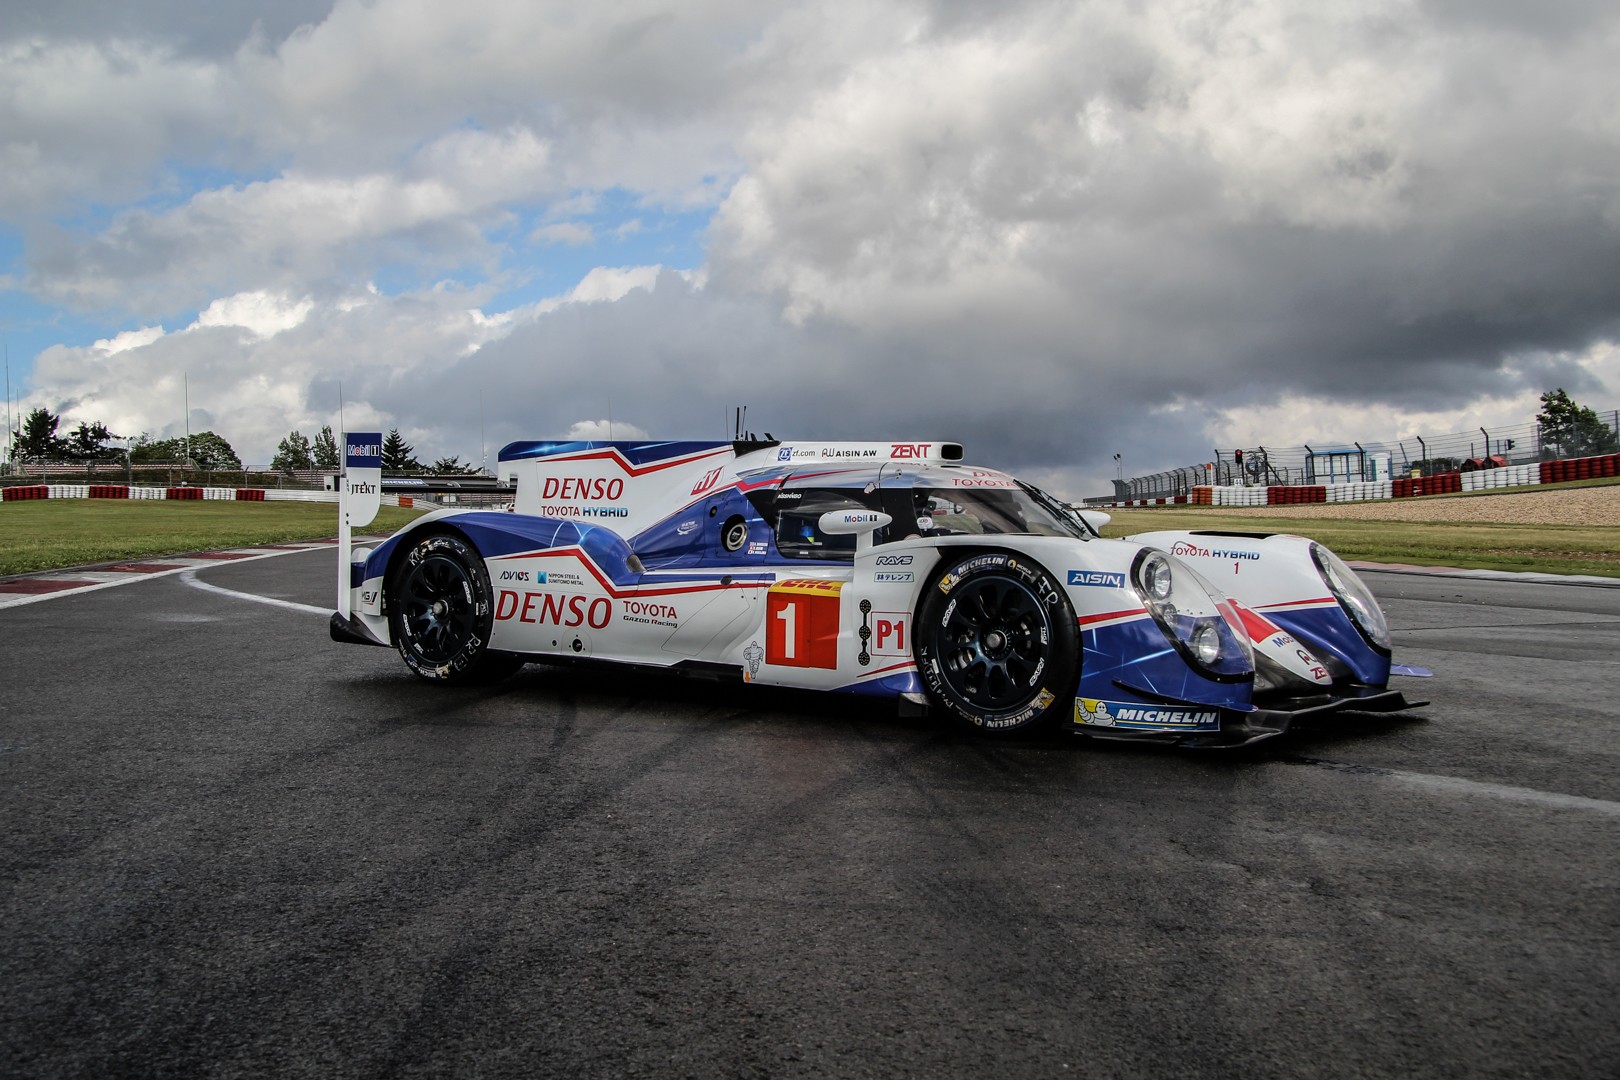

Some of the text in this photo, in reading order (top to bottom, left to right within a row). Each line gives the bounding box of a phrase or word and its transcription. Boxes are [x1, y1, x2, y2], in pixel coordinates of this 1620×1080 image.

[348, 445, 379, 456] Mobil 1
[791, 449, 816, 457] zf.com
[890, 444, 931, 459] ZENT
[351, 482, 376, 495] JTEKT
[542, 477, 624, 500] DENSO
[541, 505, 628, 517] TOYOTA HYBRID
[876, 556, 913, 565] RAYS
[1212, 549, 1260, 560] HYBRID
[957, 557, 1004, 575] MICHELIN
[1233, 562, 1239, 574] 1
[500, 571, 529, 581] ADVICS
[877, 573, 912, 581] 林テレンプ
[1072, 573, 1120, 585] AISIN
[495, 590, 612, 629] DENSO
[623, 600, 677, 619] TOYOTA
[623, 615, 678, 629] GAZOO Racing
[776, 602, 796, 659] 1
[876, 620, 904, 650] P1
[986, 709, 1034, 728] MICHELIN
[1116, 708, 1217, 724] MICHELIN
